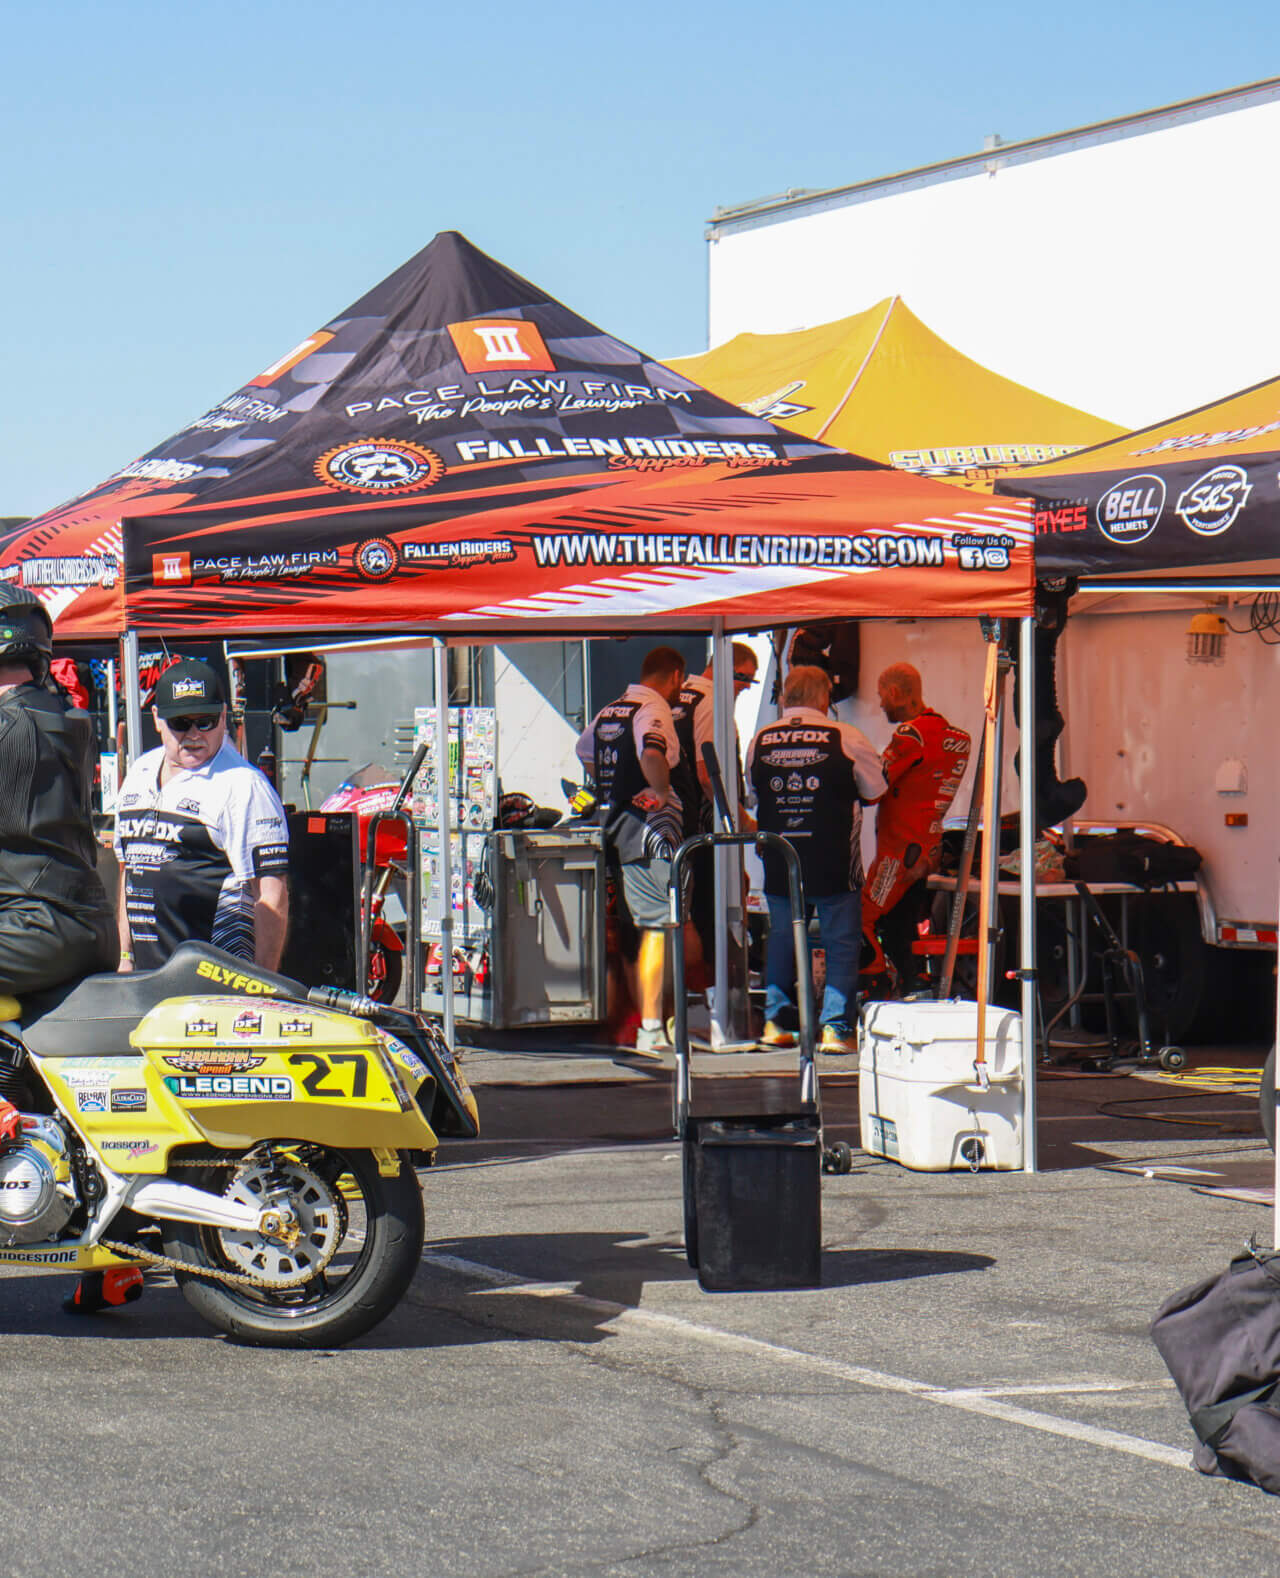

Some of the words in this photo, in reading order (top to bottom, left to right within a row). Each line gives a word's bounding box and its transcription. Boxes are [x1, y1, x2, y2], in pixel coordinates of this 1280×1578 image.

[345, 384, 467, 417] PACE
[479, 377, 567, 397] LAW
[584, 381, 692, 403] FIRM
[408, 401, 456, 425] The
[460, 393, 553, 419] People's
[560, 393, 644, 414] Lawyer
[608, 455, 709, 473] Support
[1105, 487, 1156, 521] BELL
[1189, 481, 1242, 513] S&S
[1035, 506, 1089, 536] AYES
[1110, 519, 1149, 534] HELMETS
[533, 535, 946, 567] WWW.THEFALLENRIDERS.COM
[953, 535, 985, 547] Follow
[986, 536, 1001, 547] Us
[1001, 536, 1015, 547] On
[193, 556, 243, 570] PACE
[248, 554, 286, 567] LAW
[291, 550, 338, 564] FIRM
[451, 551, 486, 566] Support
[760, 730, 831, 746] SLYFOX
[120, 818, 185, 844] SLYFOX
[180, 1077, 292, 1094] LEGEND
[288, 1053, 369, 1098] 27
